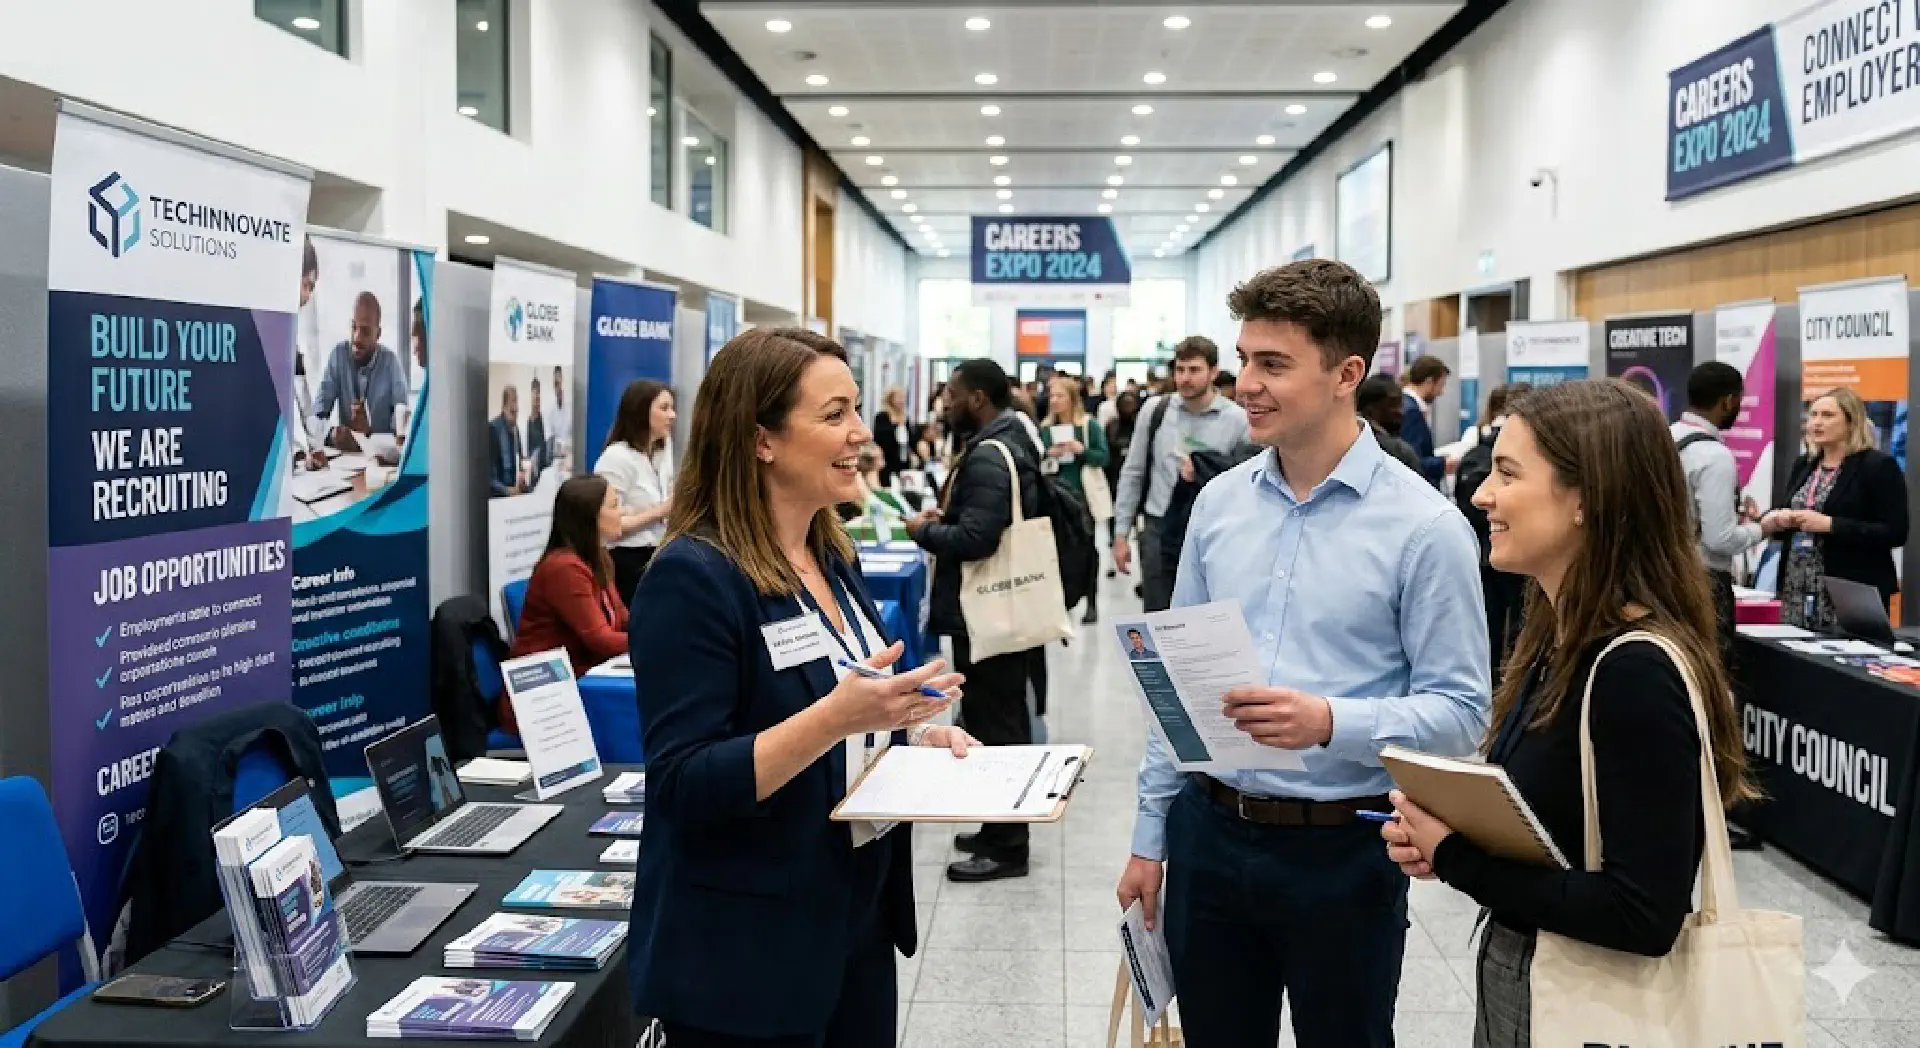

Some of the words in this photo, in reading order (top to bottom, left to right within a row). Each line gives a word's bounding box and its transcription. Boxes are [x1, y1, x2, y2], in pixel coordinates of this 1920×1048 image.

[1803, 0, 1902, 76] CONNECT
[1676, 58, 1755, 129] CAREERS
[1673, 119, 1719, 173] EXPO
[1721, 99, 1771, 158] 2024
[149, 195, 291, 243] TECHINNOVATE
[985, 223, 1081, 251] CAREERS
[149, 229, 237, 259] SOLUTIONS
[985, 253, 1042, 279] EXPO
[1045, 253, 1101, 279] 2024
[91, 315, 168, 361] BUILD
[176, 321, 236, 363] YOUR
[596, 315, 638, 338] GLOBE
[639, 319, 672, 341] BANK
[1805, 316, 1833, 341] CITY
[1836, 309, 1894, 338] COUNCIL
[91, 368, 192, 412] FUTURE
[92, 428, 133, 471] WE
[138, 427, 183, 468] ARE
[93, 470, 228, 522] RECRUITING
[93, 565, 138, 606] JOB
[141, 540, 286, 596] OPPORTUNITIES
[1743, 702, 1788, 766] CITY
[1791, 723, 1897, 817] COUNCIL
